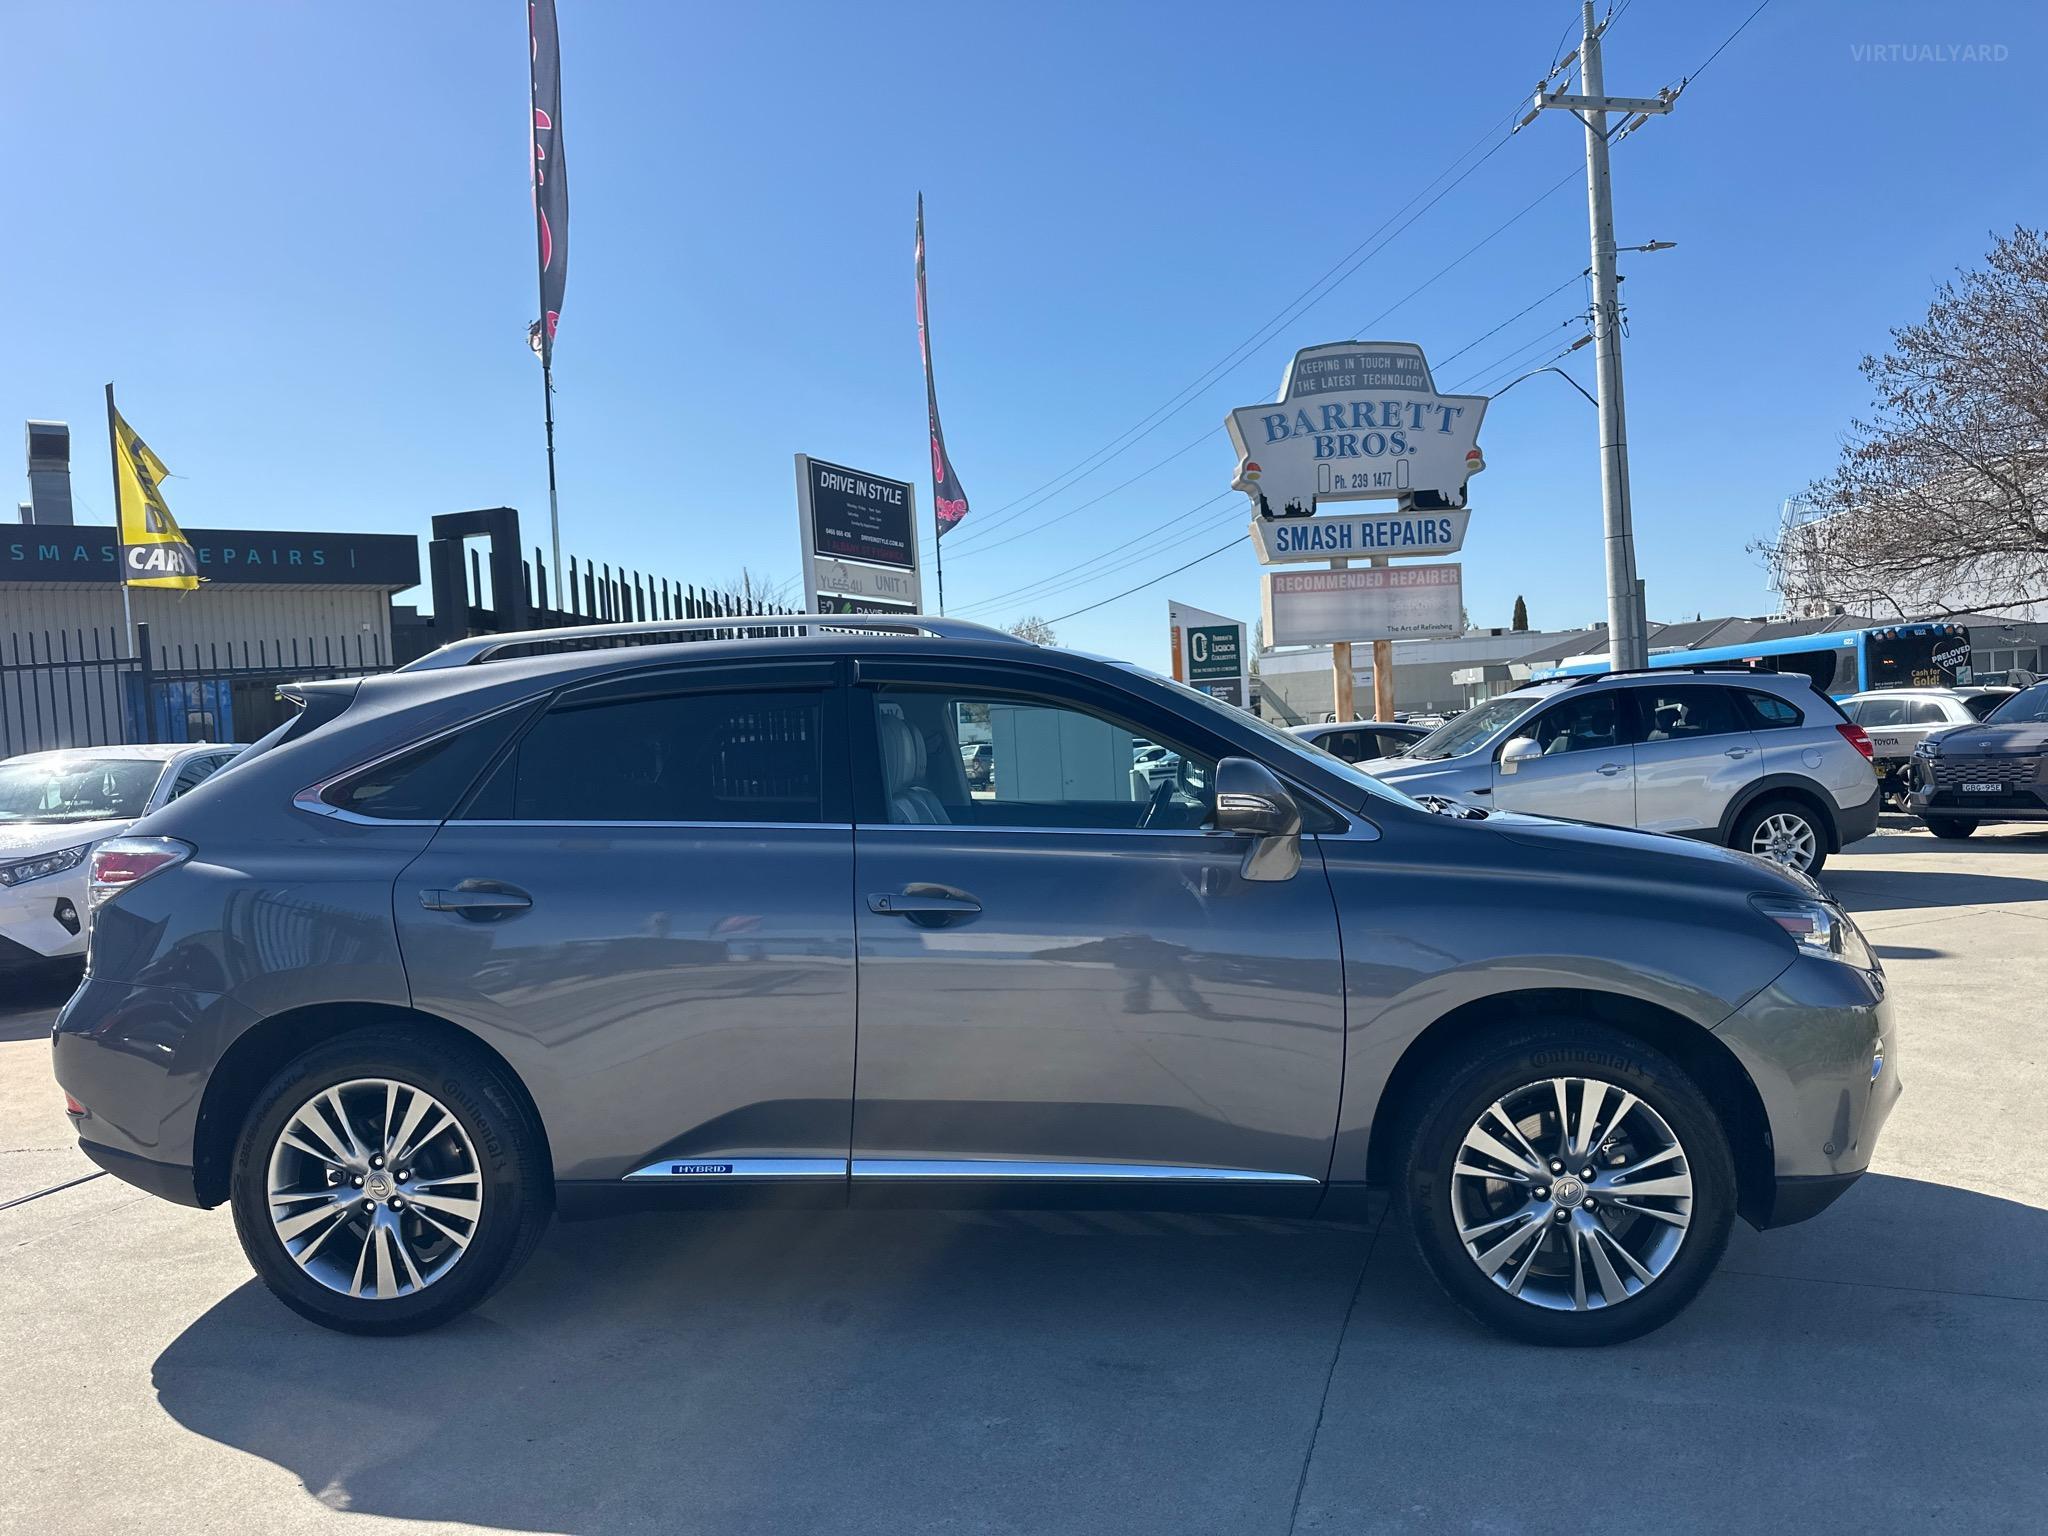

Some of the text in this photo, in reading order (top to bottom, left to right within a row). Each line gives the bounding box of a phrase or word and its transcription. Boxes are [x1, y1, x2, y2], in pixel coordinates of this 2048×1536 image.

[1300, 357, 1420, 375] KEEPING IN TOUCH WITH
[1297, 374, 1424, 393] THE LATEST TECHNOLOGY
[1260, 399, 1465, 445] BARRETT
[1313, 430, 1418, 461] BROS.
[821, 471, 903, 505] DRIVE IN STYLE
[1335, 471, 1393, 490] Ph. 239 1477
[1276, 518, 1452, 552] SMASH REPAIRS
[10, 543, 326, 567] SMAS EPAIRS
[128, 546, 185, 574] CARS
[875, 575, 900, 592] UNIT
[902, 580, 908, 593] 1
[1276, 568, 1459, 593] RECOMMENDED REPAIRER
[1401, 624, 1412, 632] Art
[1421, 622, 1453, 631] Refinishing
[1931, 645, 1971, 663] PRELOVED
[1943, 655, 1964, 668] GOLD
[1911, 669, 1928, 677] Cash
[1913, 676, 1940, 687] Gold!
[1873, 738, 1899, 746] TOYOTA
[1529, 1046, 1633, 1073] Continental
[441, 1078, 505, 1160] Continental
[679, 1165, 727, 1173] HYBRID
